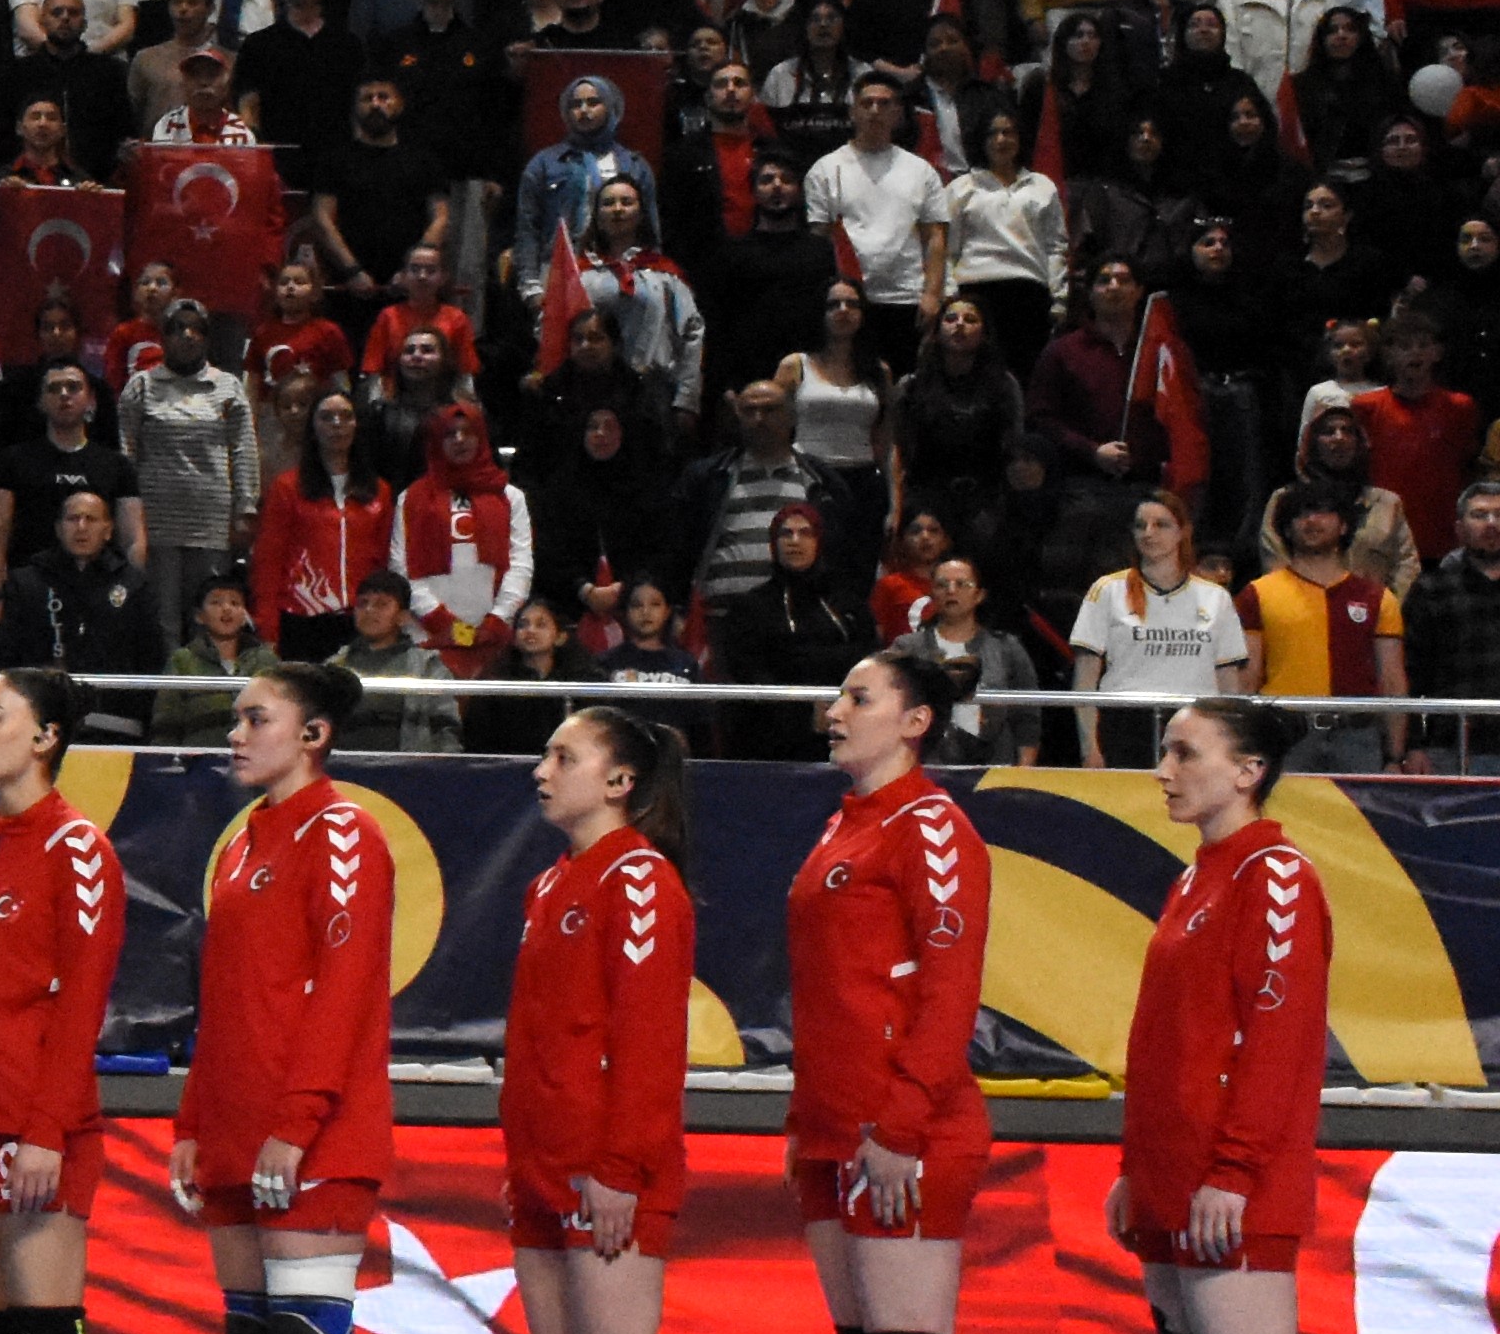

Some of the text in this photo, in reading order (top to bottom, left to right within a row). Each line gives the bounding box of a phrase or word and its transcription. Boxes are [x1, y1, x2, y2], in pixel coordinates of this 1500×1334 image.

[1132, 625, 1212, 643] Emirates
[1143, 643, 1202, 657] FLY BETTER
